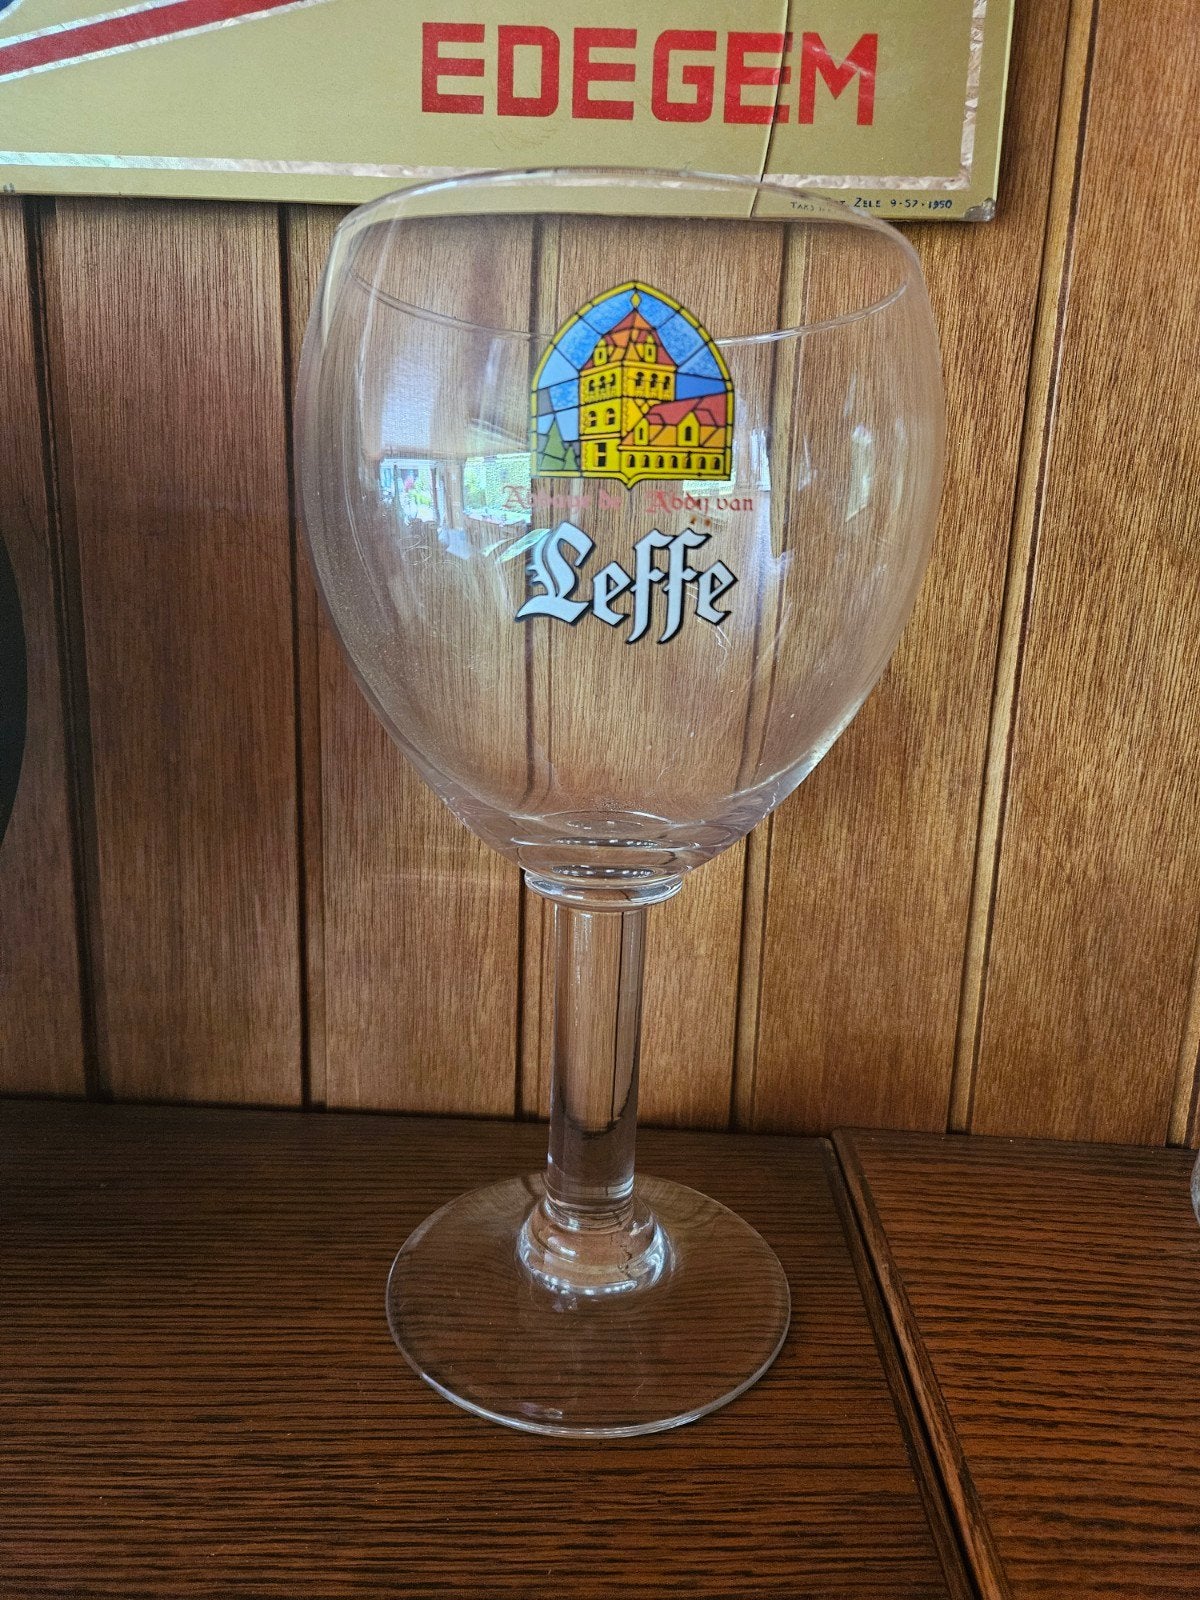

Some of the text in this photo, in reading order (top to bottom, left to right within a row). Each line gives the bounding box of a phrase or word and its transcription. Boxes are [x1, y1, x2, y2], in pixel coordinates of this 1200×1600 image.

[422, 22, 878, 126] EDEGEM
[716, 497, 754, 512] van
[515, 521, 738, 645] Leffe
